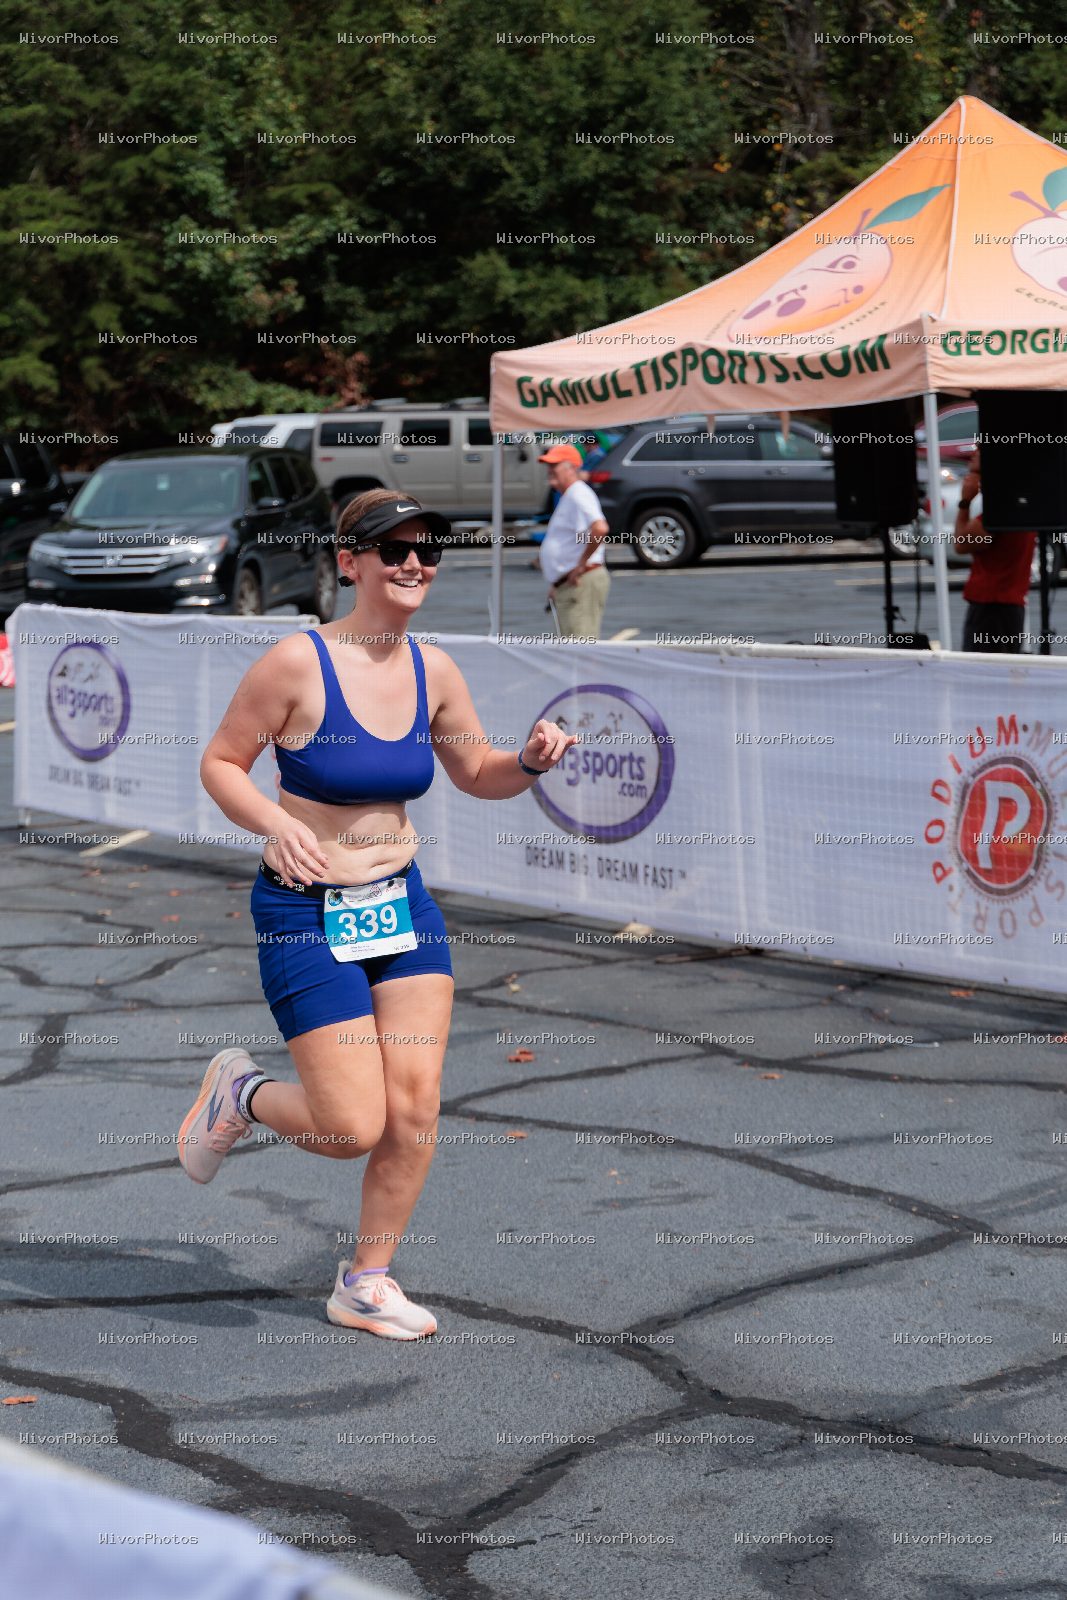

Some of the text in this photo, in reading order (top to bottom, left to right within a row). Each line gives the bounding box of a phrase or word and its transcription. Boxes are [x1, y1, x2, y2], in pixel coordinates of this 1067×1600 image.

[942, 327, 1067, 356] GEORGI
[516, 334, 891, 408] GAMULTISPORTS.COM
[556, 747, 645, 787] 3sports
[924, 714, 1019, 885] PODIUM
[525, 845, 565, 870] DREAM
[597, 857, 639, 885] DREAM
[338, 904, 397, 943] 339
